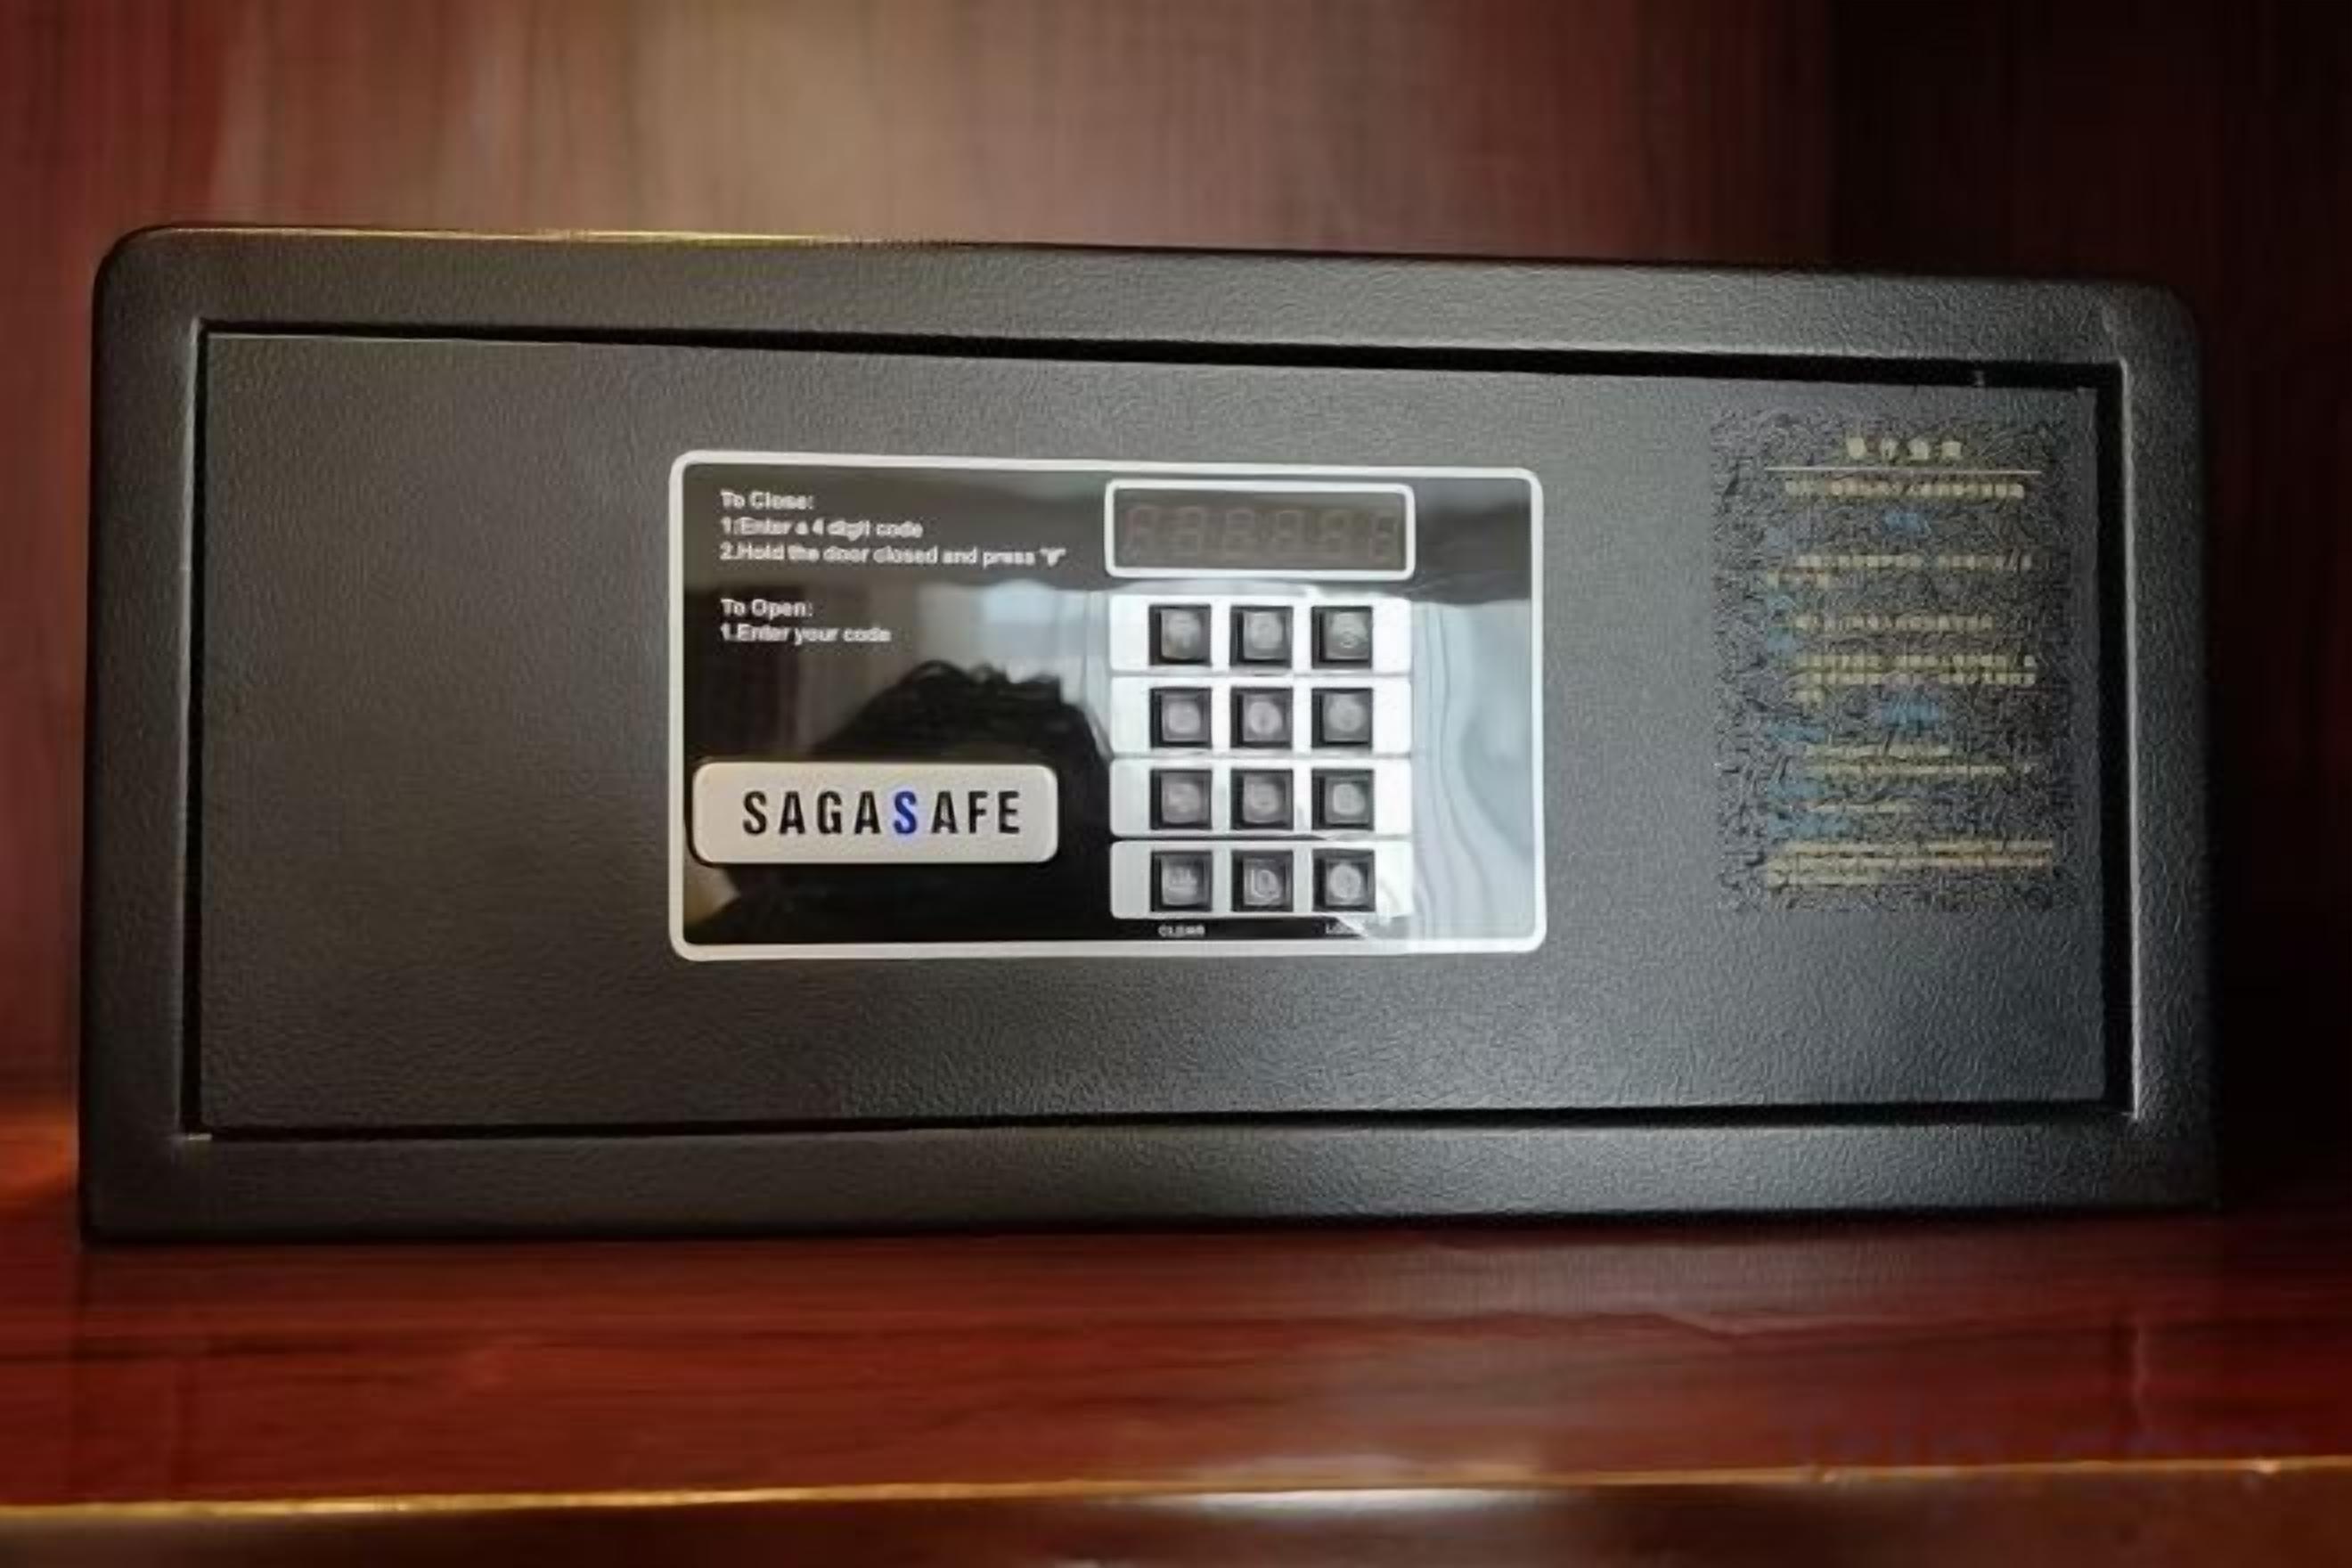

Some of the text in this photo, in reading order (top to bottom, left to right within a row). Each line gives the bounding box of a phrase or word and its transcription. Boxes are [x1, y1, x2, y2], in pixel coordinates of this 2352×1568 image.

[720, 491, 813, 510] To Close:
[795, 521, 809, 535] a
[826, 519, 870, 542] digit
[876, 520, 923, 538] code
[788, 544, 820, 562] the
[823, 544, 870, 563] door
[873, 545, 938, 564] closed
[943, 546, 977, 564] and
[983, 551, 1036, 568] press
[720, 599, 813, 620] To Open:
[794, 627, 840, 646] your
[843, 625, 891, 642] code
[742, 789, 1021, 836] SAGASAFE
